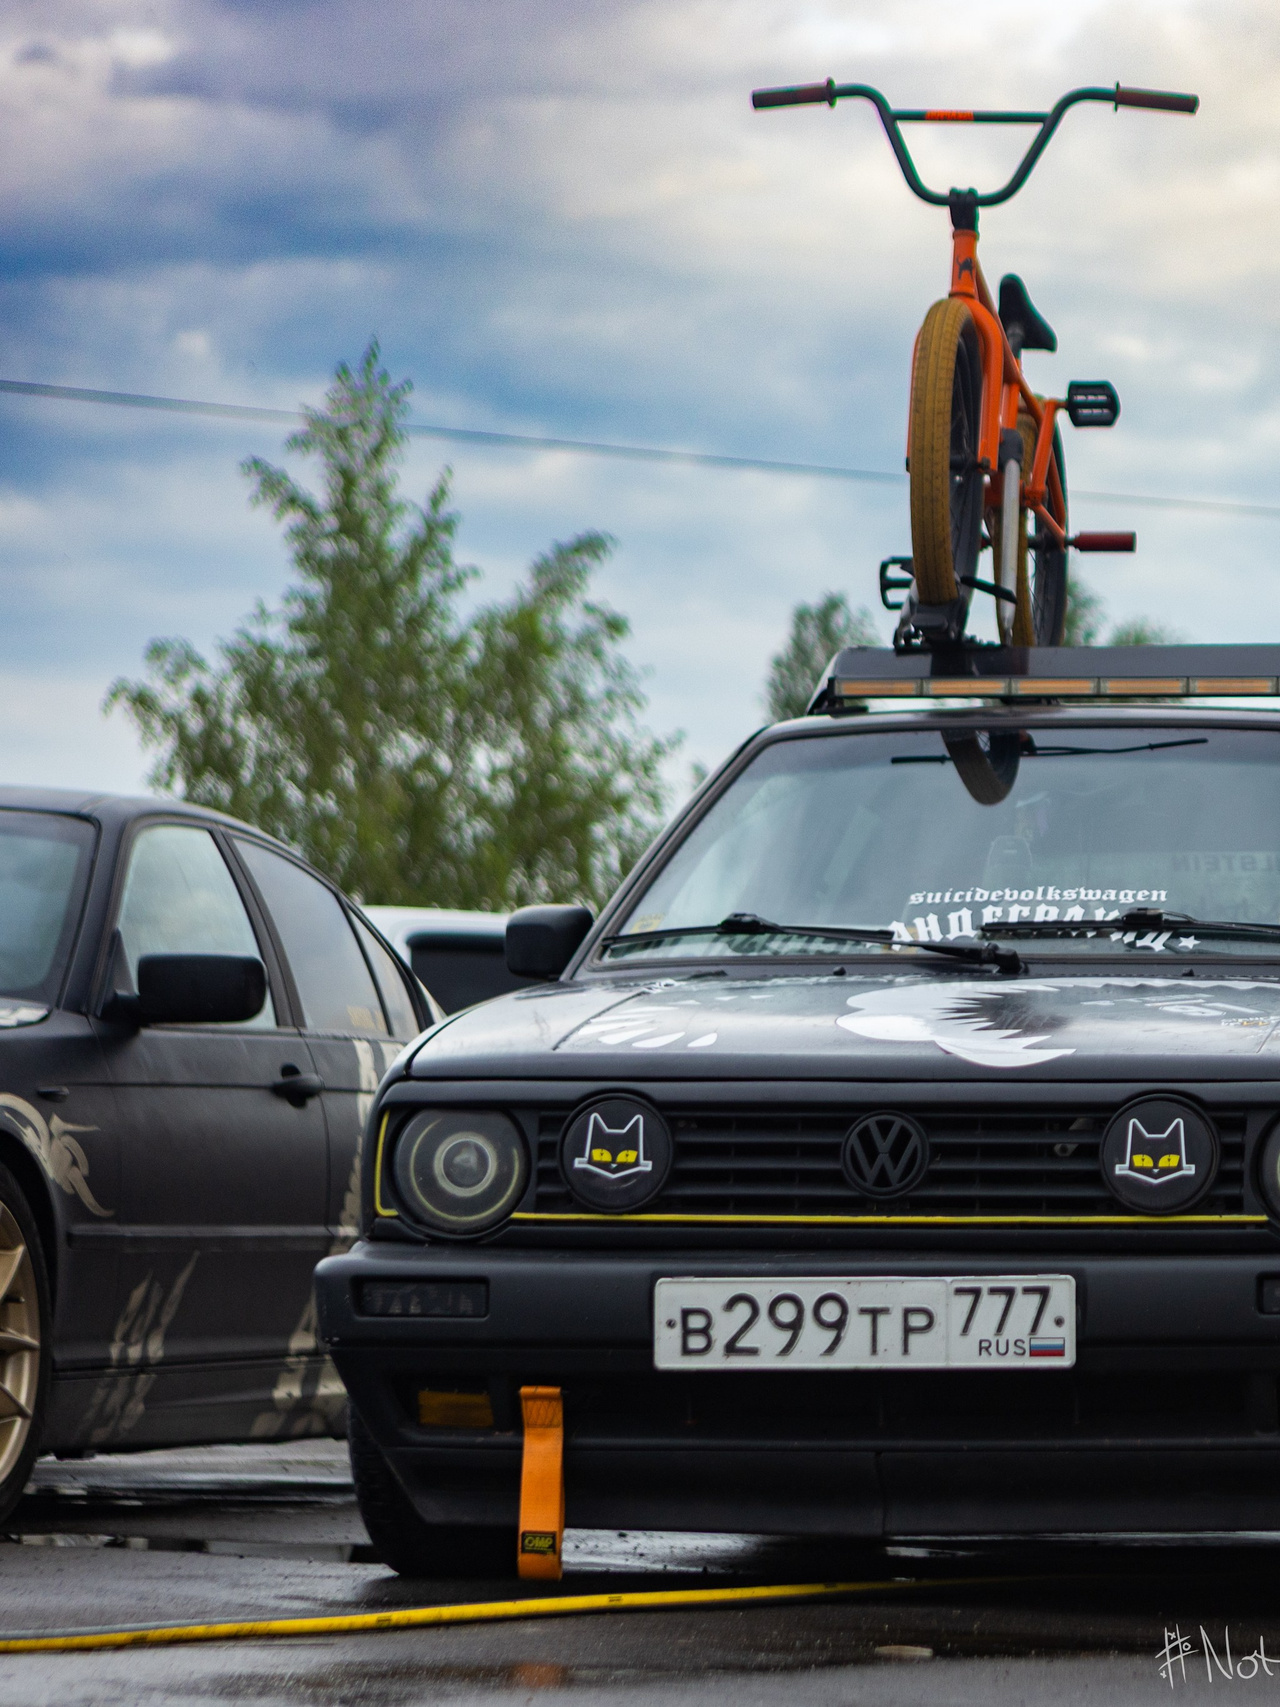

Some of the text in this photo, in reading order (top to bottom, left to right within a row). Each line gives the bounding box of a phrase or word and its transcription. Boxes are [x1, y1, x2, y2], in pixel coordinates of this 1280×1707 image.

[908, 886, 1168, 905] suicidevolkswagen
[846, 1114, 922, 1192] VW
[953, 1285, 1052, 1336] 777
[978, 1339, 1027, 1356] RUS
[524, 1536, 553, 1548] OMP
